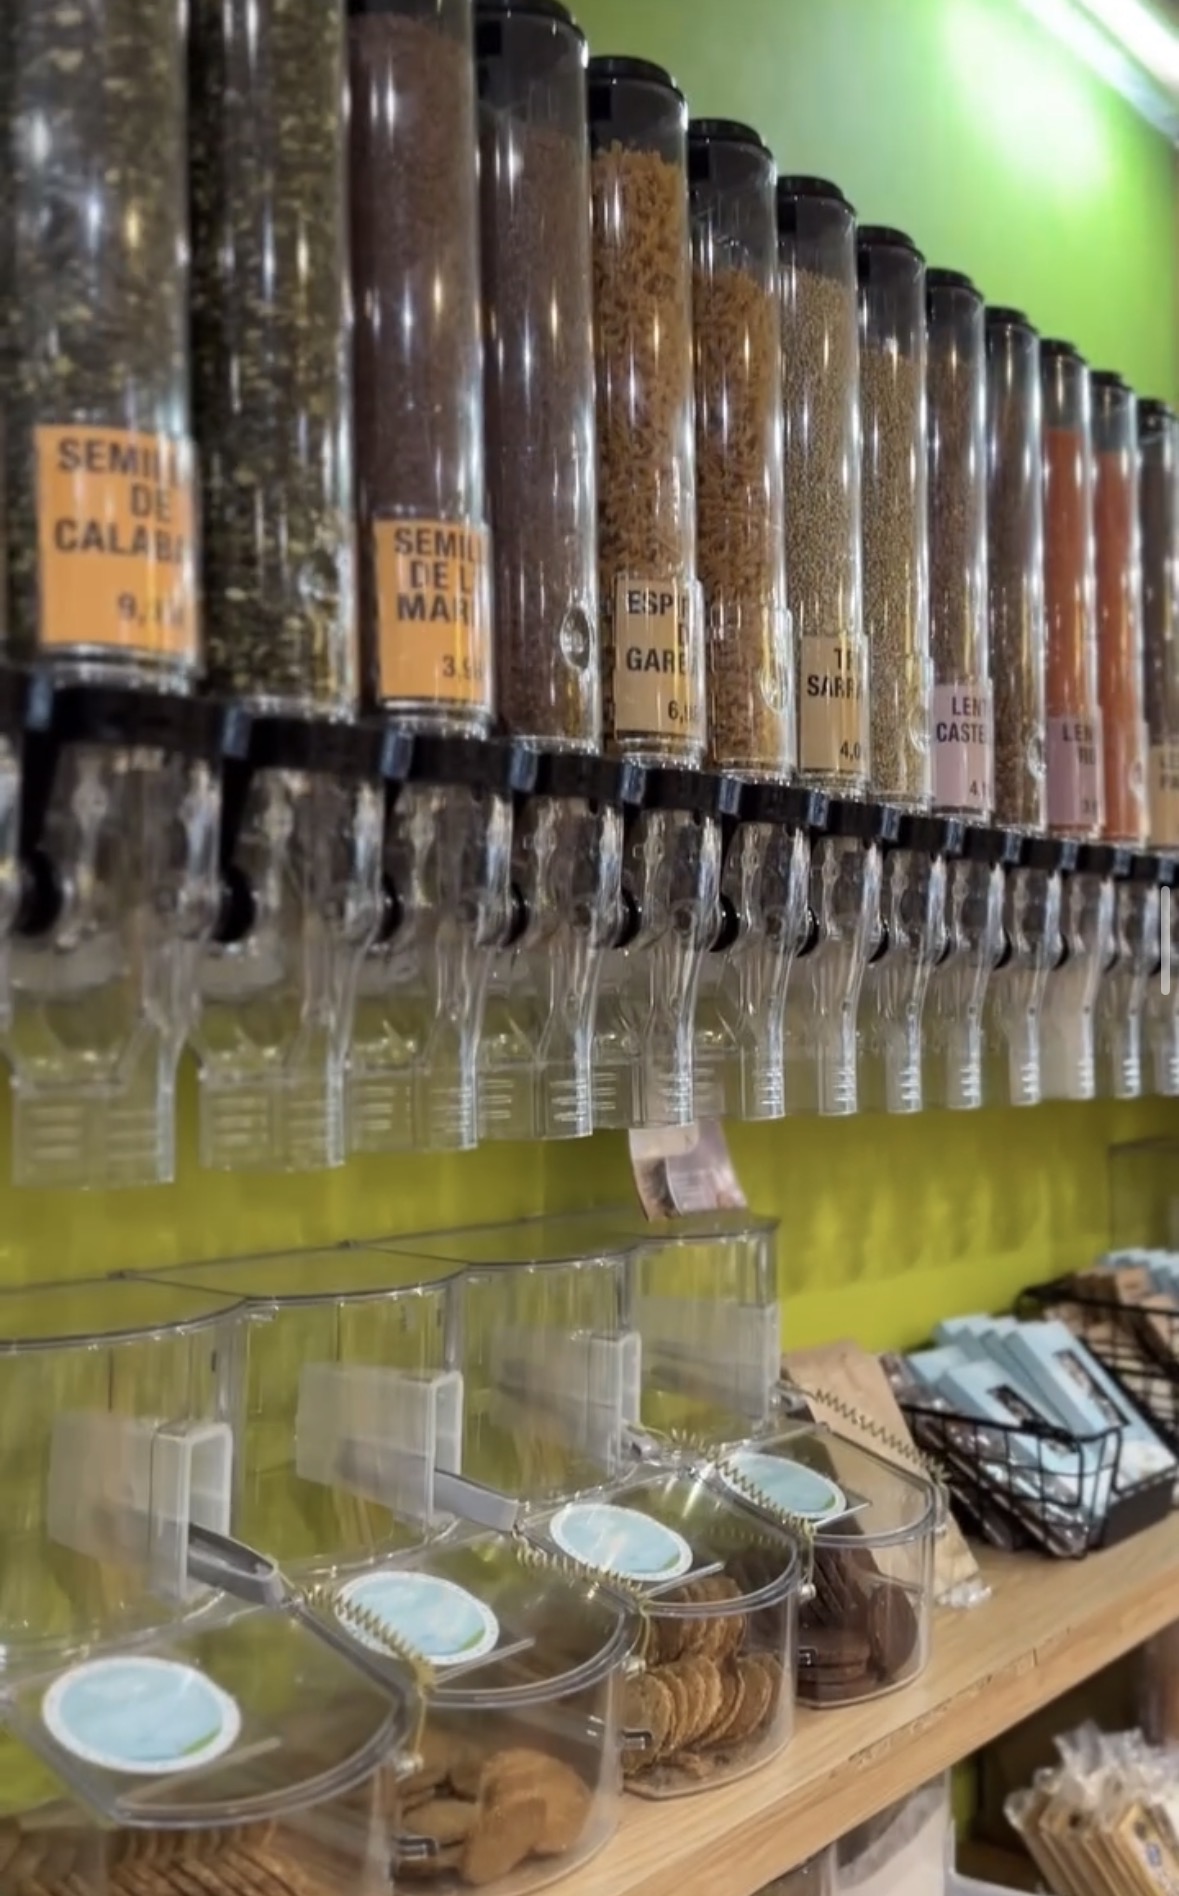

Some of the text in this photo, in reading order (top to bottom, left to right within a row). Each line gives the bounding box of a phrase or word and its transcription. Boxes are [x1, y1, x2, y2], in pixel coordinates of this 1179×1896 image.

[131, 484, 171, 522] DE
[410, 559, 449, 590] DE
[396, 592, 474, 627] MAR
[806, 674, 860, 698] SARR
[936, 721, 986, 744] CASTE
